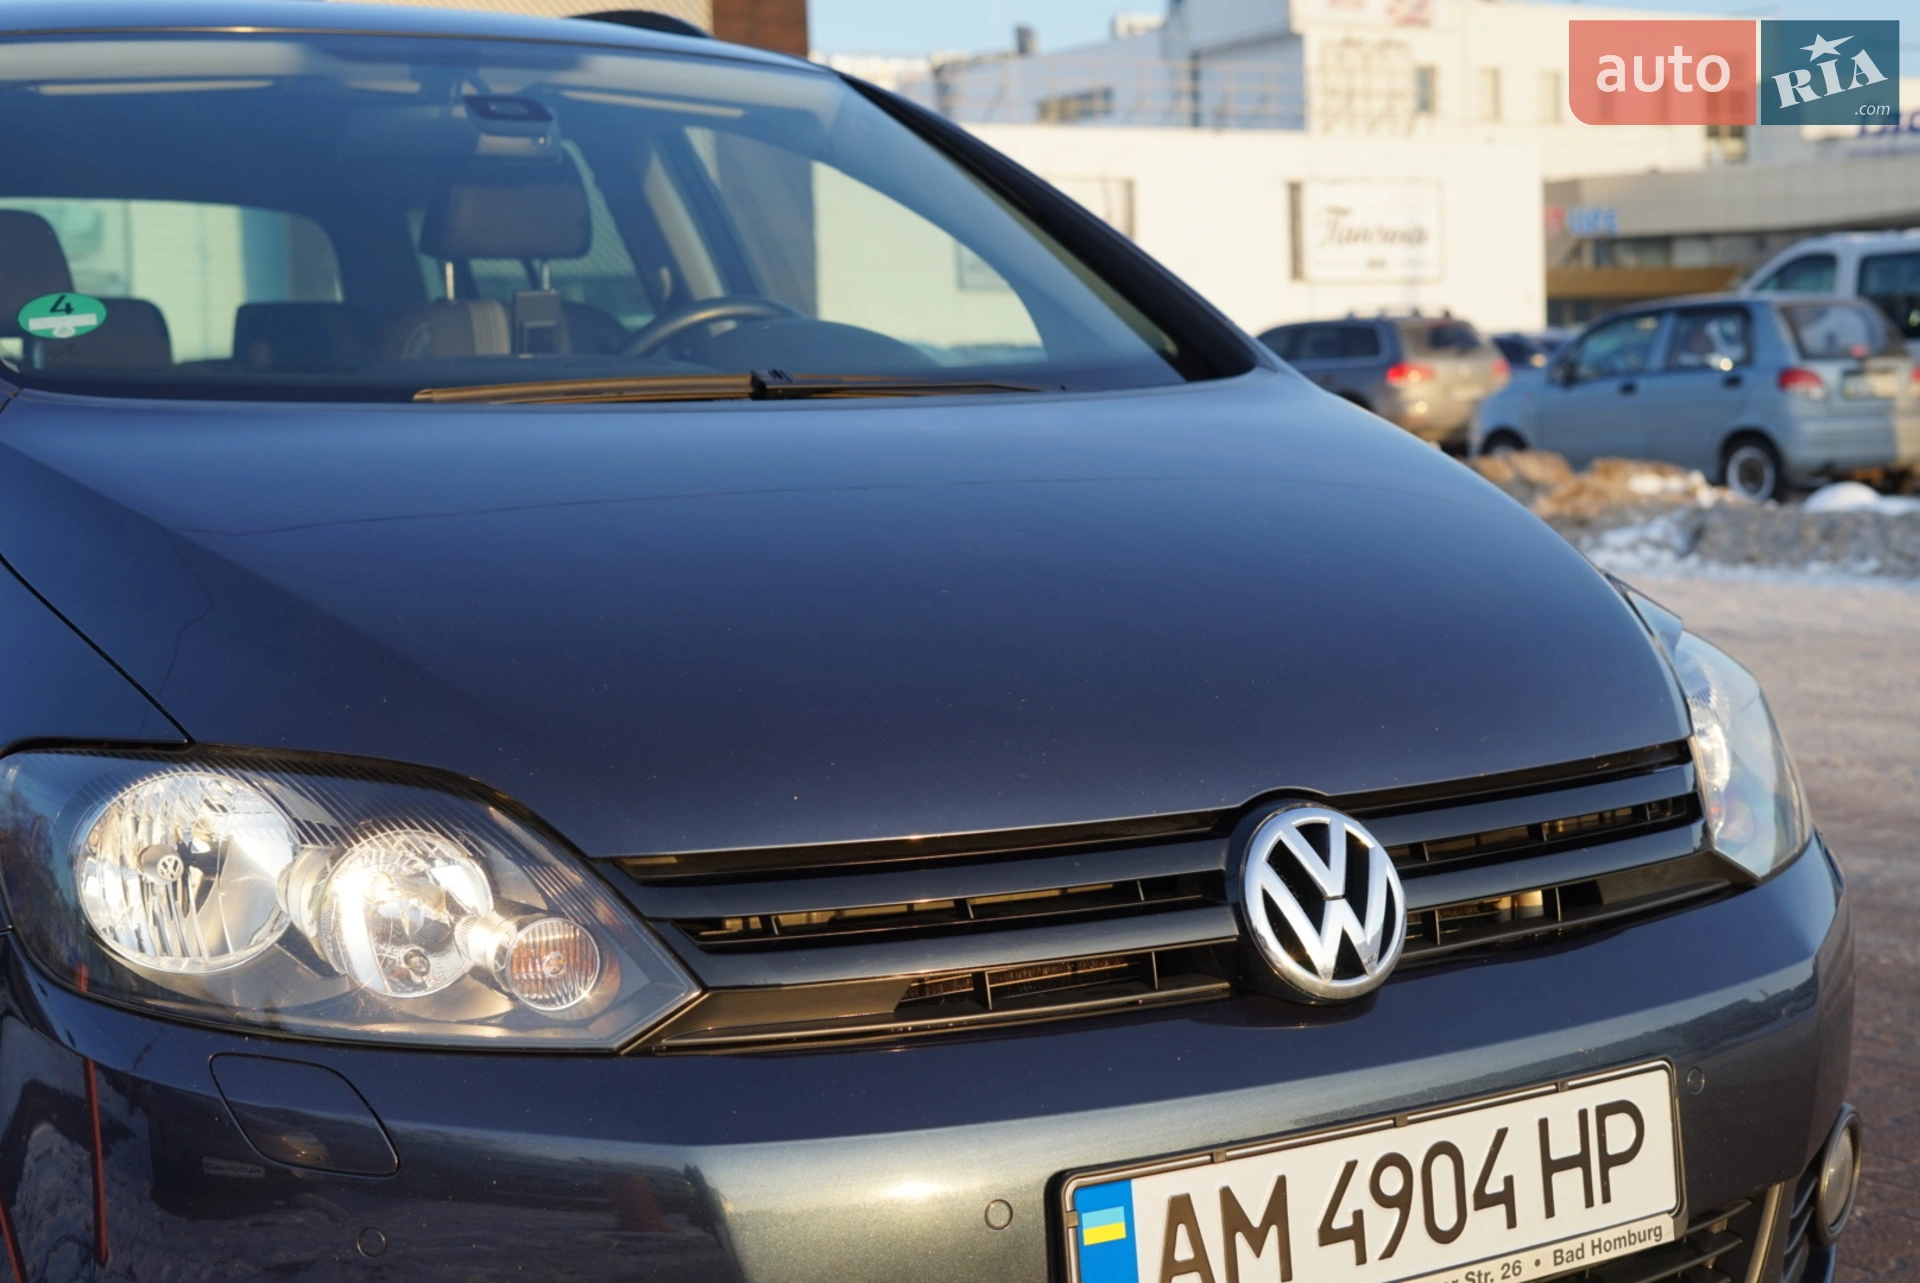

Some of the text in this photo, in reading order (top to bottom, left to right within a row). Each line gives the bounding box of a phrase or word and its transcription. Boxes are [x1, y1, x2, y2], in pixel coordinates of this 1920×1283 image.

[49, 294, 75, 315] 4
[1158, 1099, 1645, 1283] AM 4904 HP
[1501, 1260, 1522, 1280] 26
[1553, 1242, 1585, 1266] Bad
[1591, 1225, 1662, 1256] Homburg
